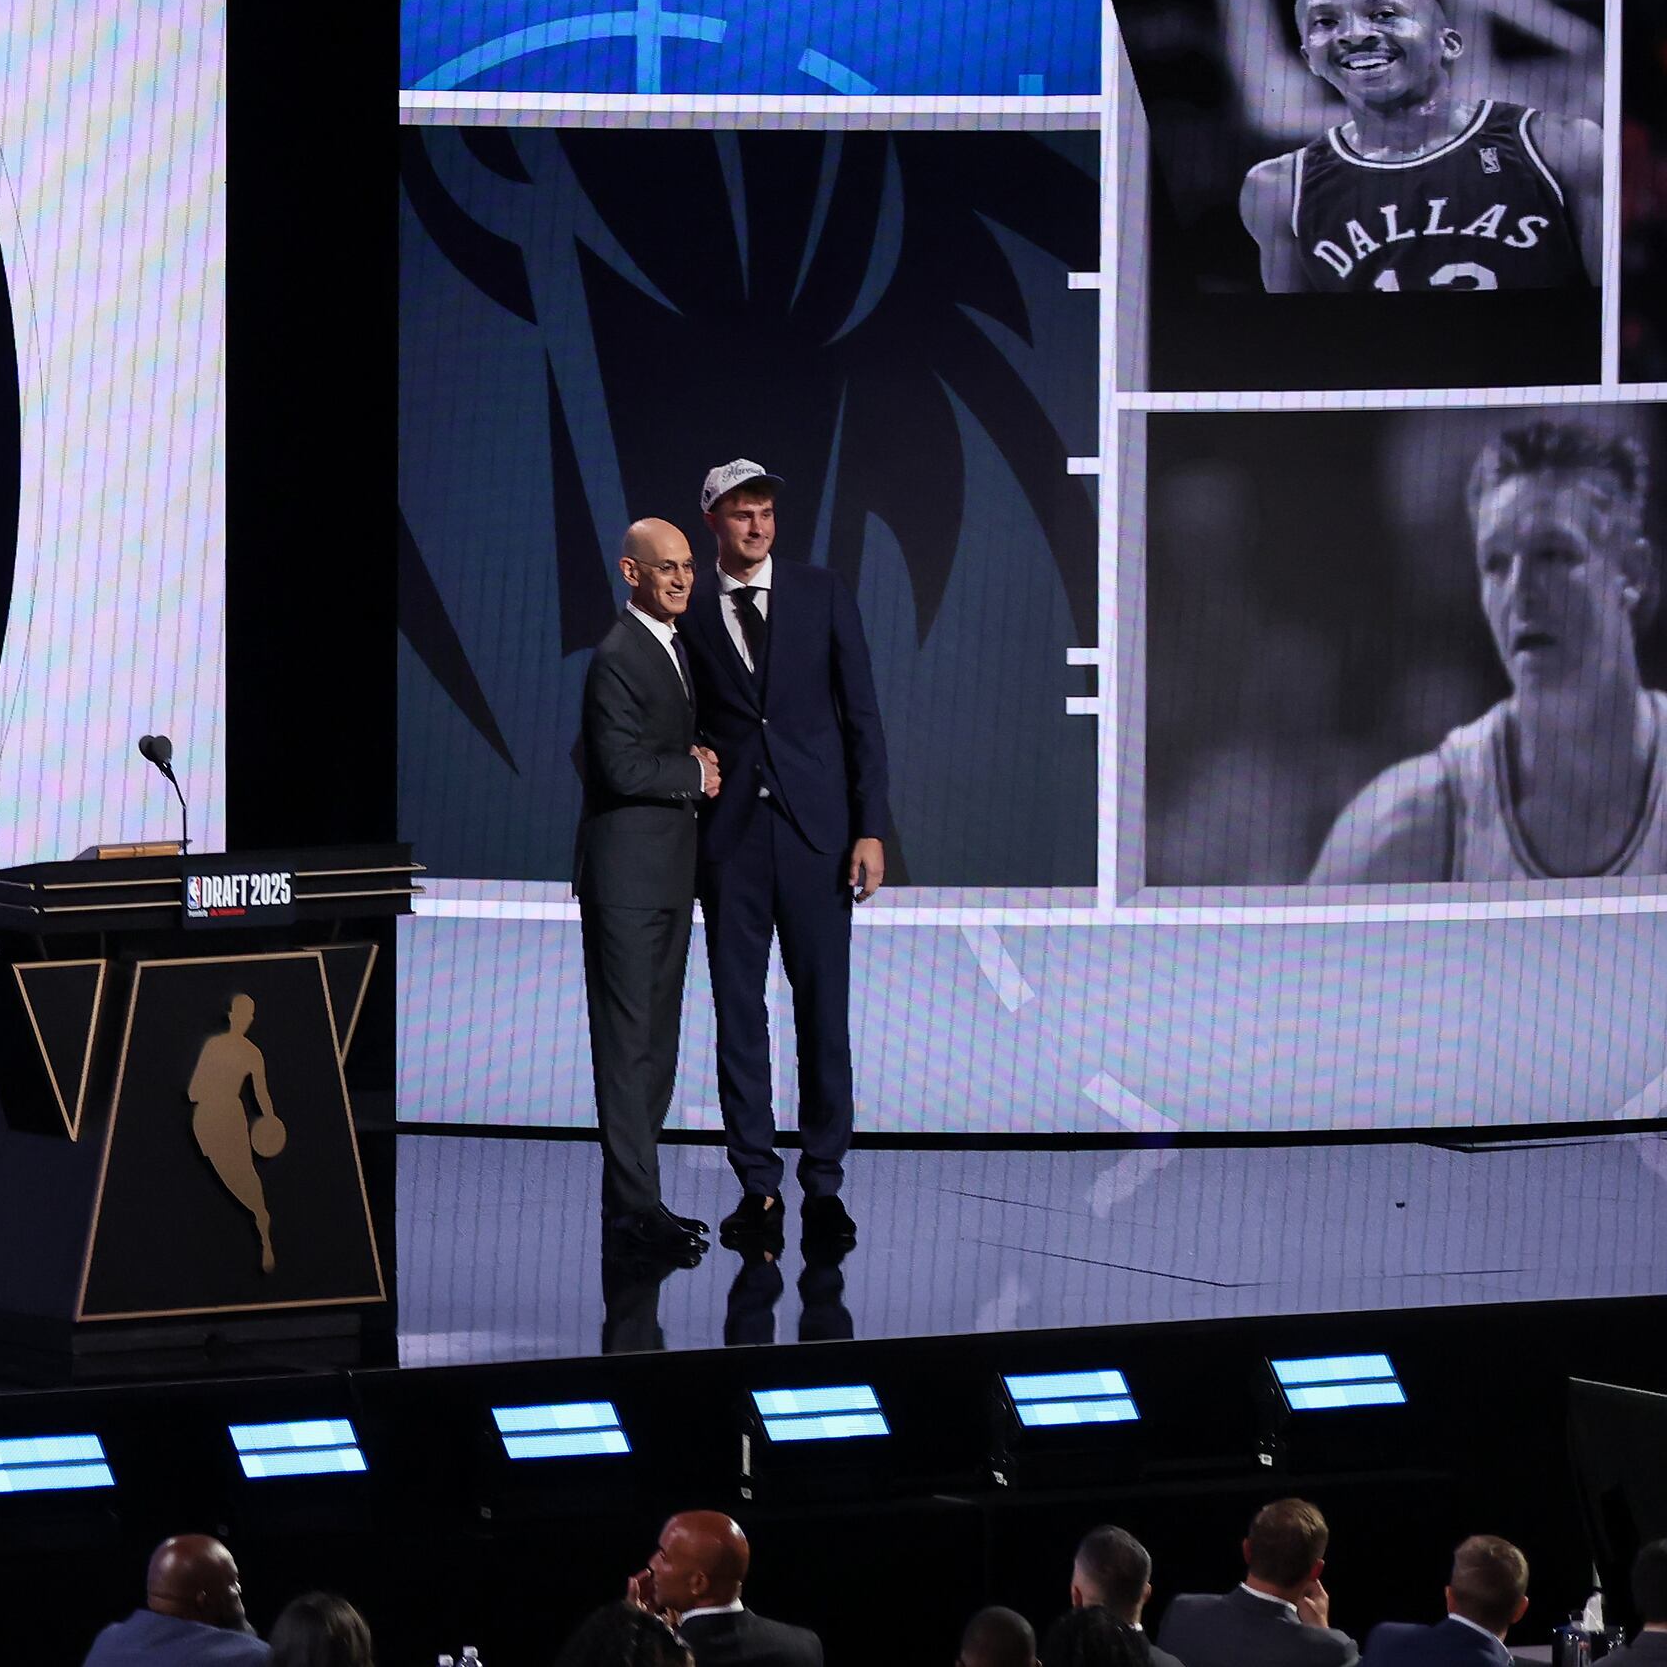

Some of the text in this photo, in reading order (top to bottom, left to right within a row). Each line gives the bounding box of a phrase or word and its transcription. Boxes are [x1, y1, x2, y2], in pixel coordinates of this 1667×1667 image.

[1313, 196, 1549, 278] DALLAS
[202, 872, 292, 908] DRAFT 2025
